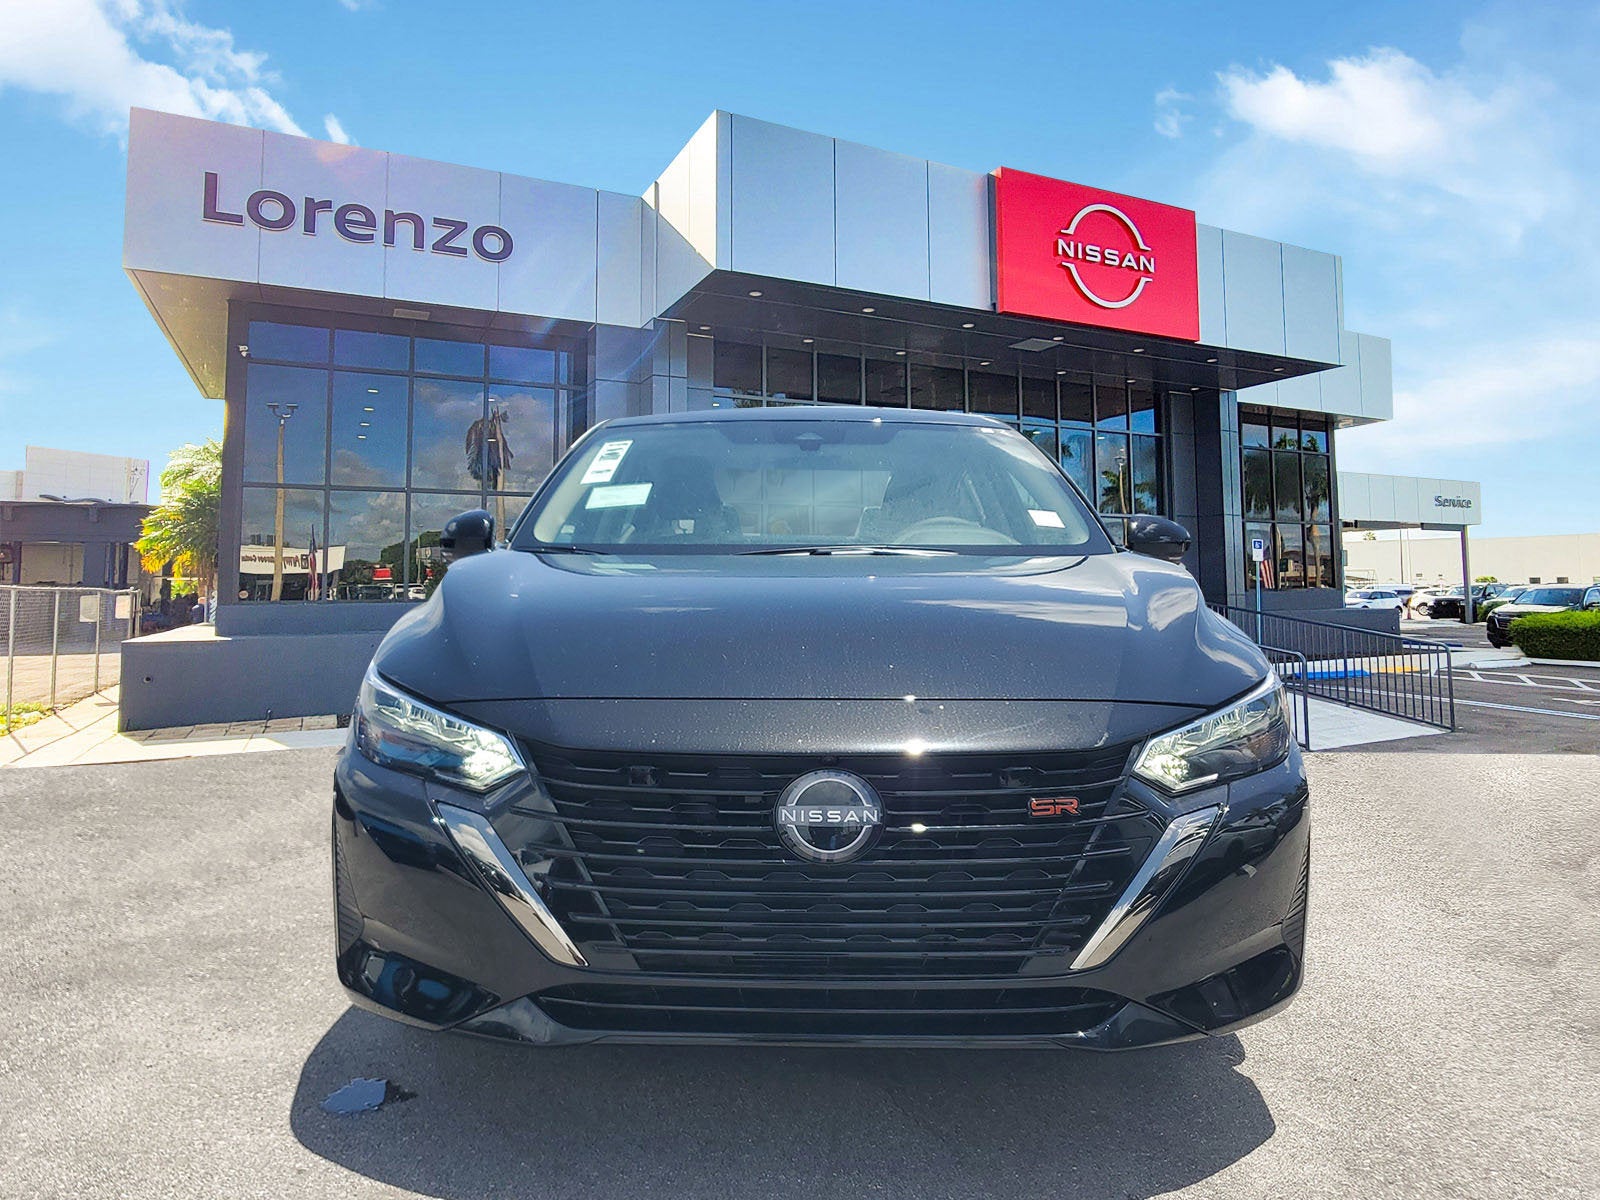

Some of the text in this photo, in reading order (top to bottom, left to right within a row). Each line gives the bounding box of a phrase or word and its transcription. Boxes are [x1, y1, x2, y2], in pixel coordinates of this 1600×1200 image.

[203, 171, 514, 262] Lorenzo
[1057, 238, 1155, 273] NISSAN
[1434, 495, 1472, 509] Service
[780, 807, 879, 824] NISSAN
[1029, 797, 1082, 816] SR
